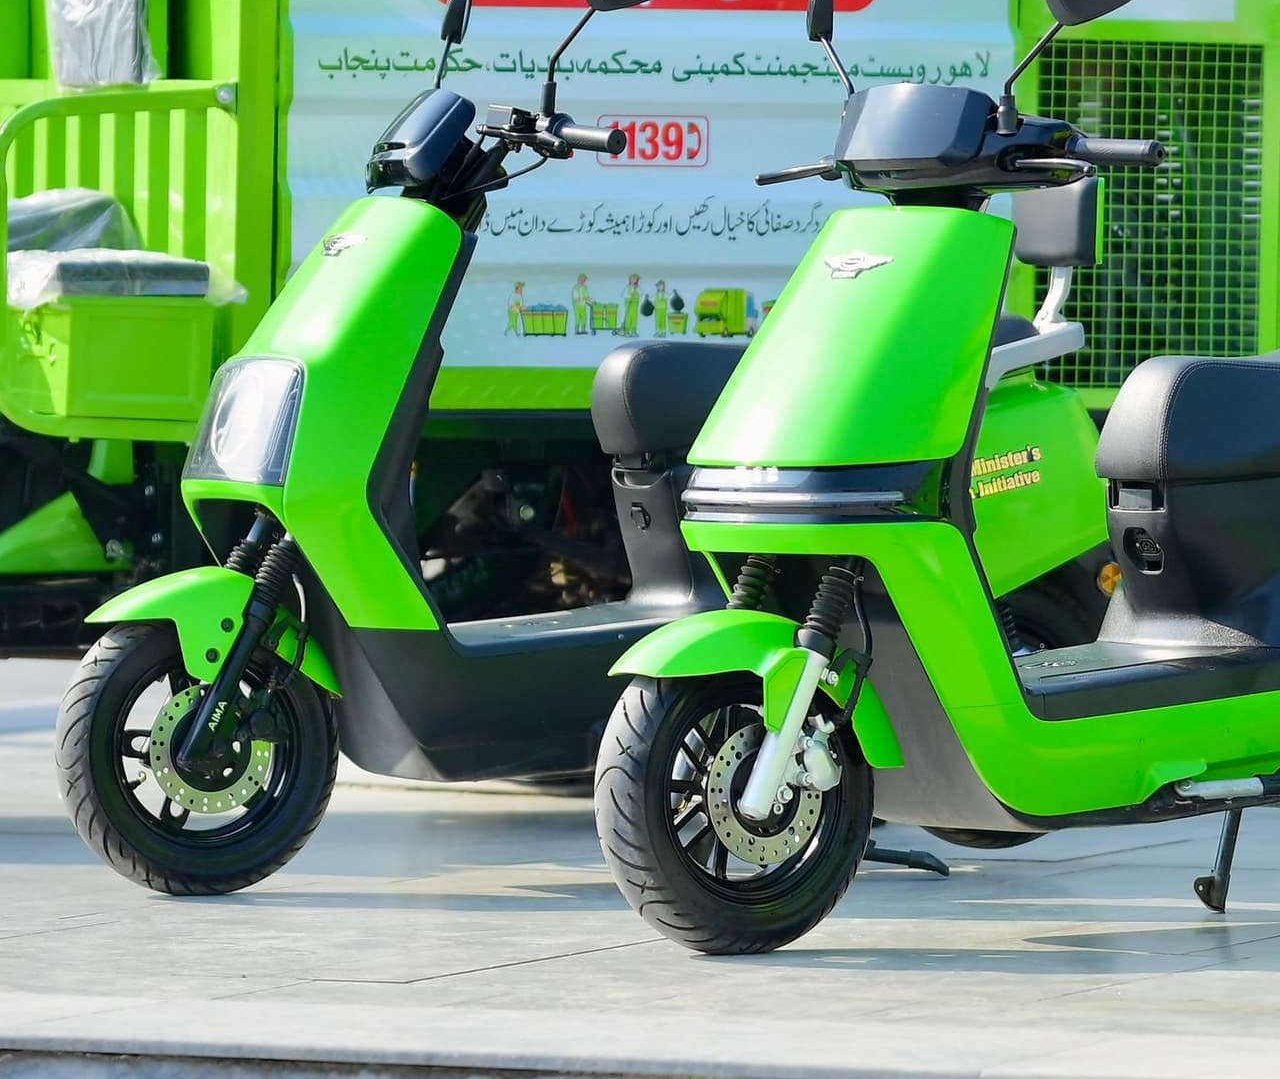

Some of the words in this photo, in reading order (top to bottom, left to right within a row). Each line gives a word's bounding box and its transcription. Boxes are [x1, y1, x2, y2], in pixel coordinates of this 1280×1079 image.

[318, 46, 391, 80] پنجاب
[672, 51, 746, 83] کمپنی
[971, 445, 1042, 477] Minister's
[978, 469, 1041, 498] Initiative
[208, 701, 228, 732] AIMA
